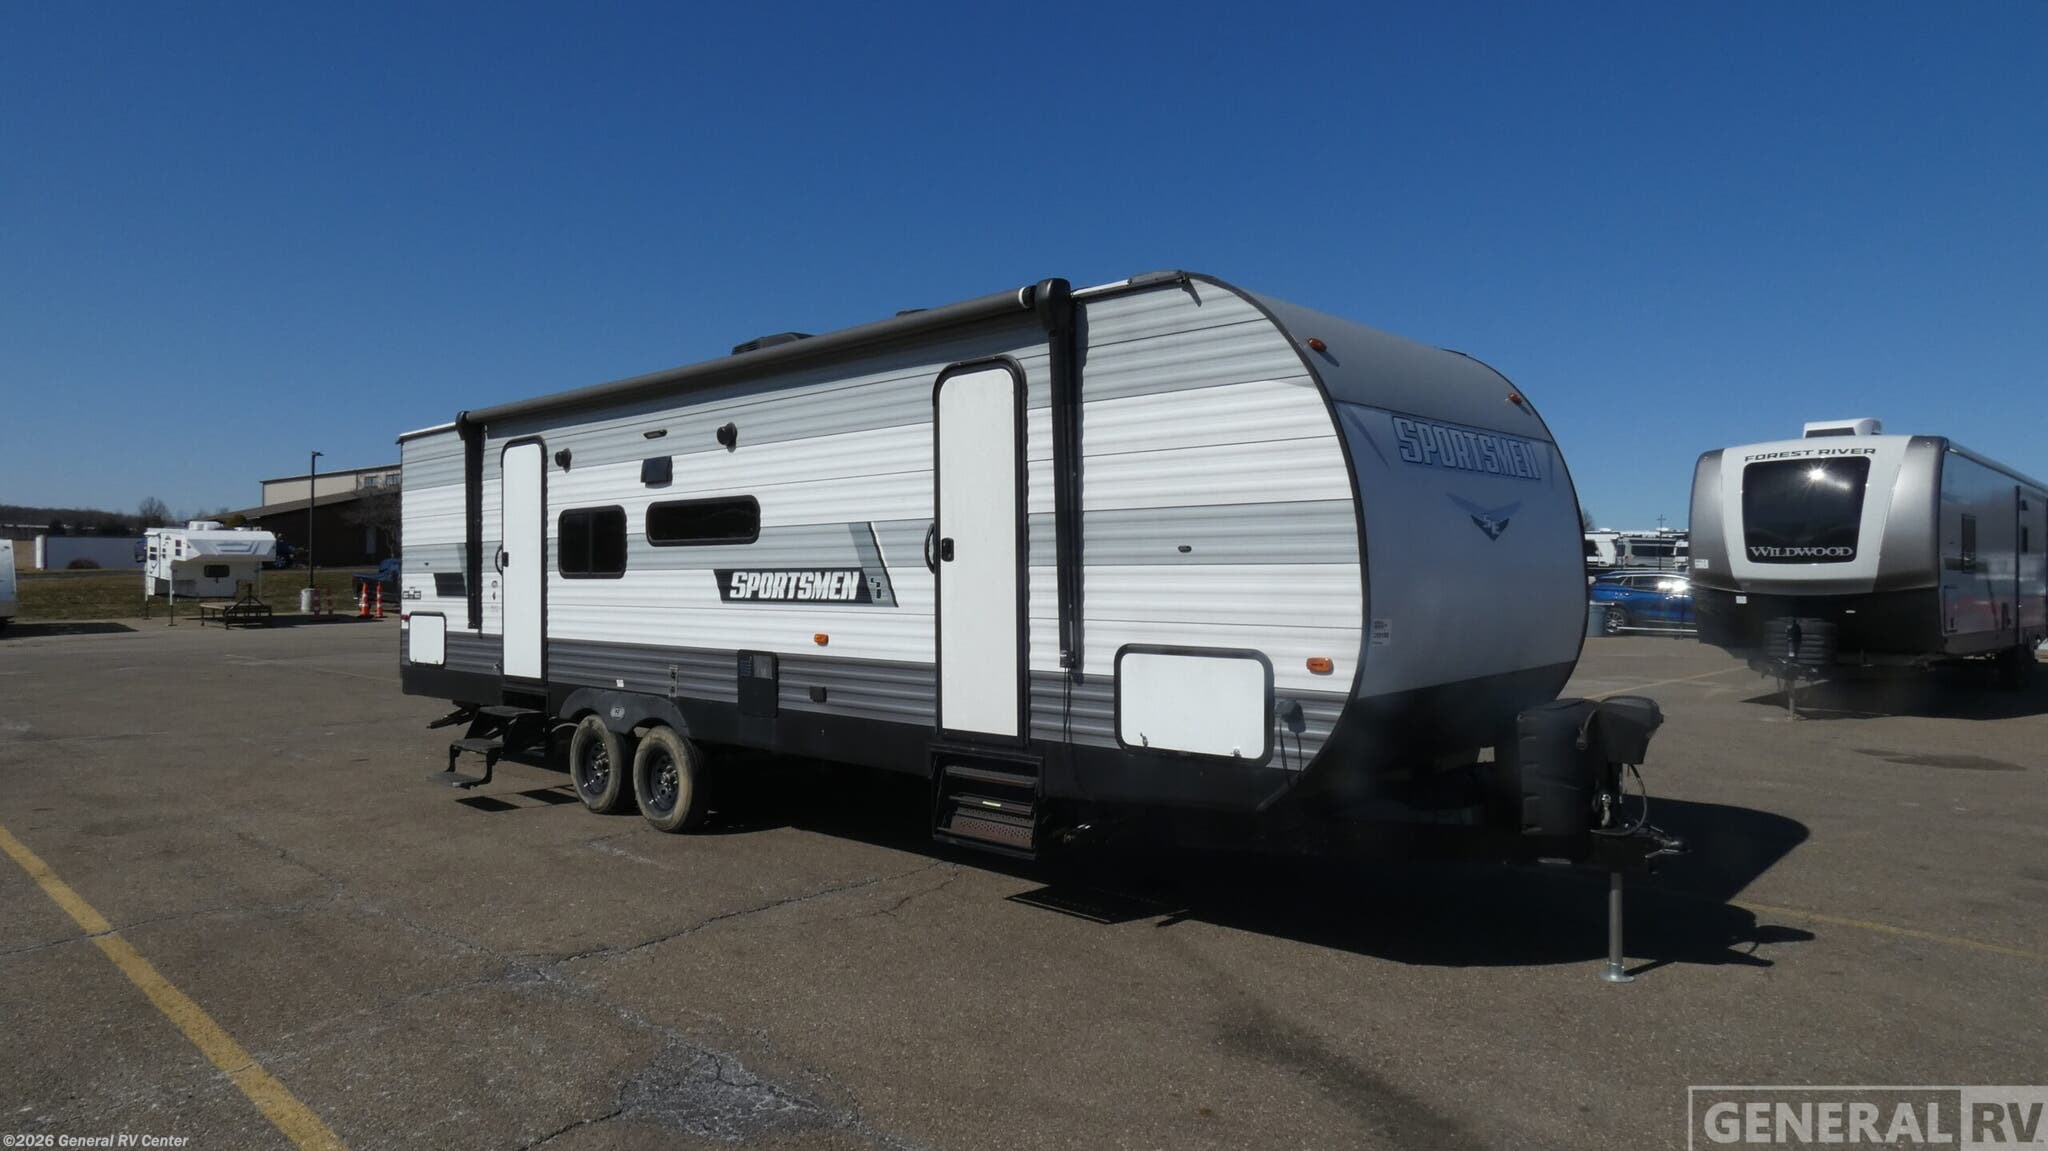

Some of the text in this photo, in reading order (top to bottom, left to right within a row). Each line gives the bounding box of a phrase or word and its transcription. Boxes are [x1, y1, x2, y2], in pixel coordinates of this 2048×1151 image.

[1392, 416, 1542, 481] SPORTSMEN
[1744, 447, 1877, 462] FOREST RIVER
[1750, 546, 1854, 557] WILDWOOD
[729, 571, 860, 600] SPORTSMEN
